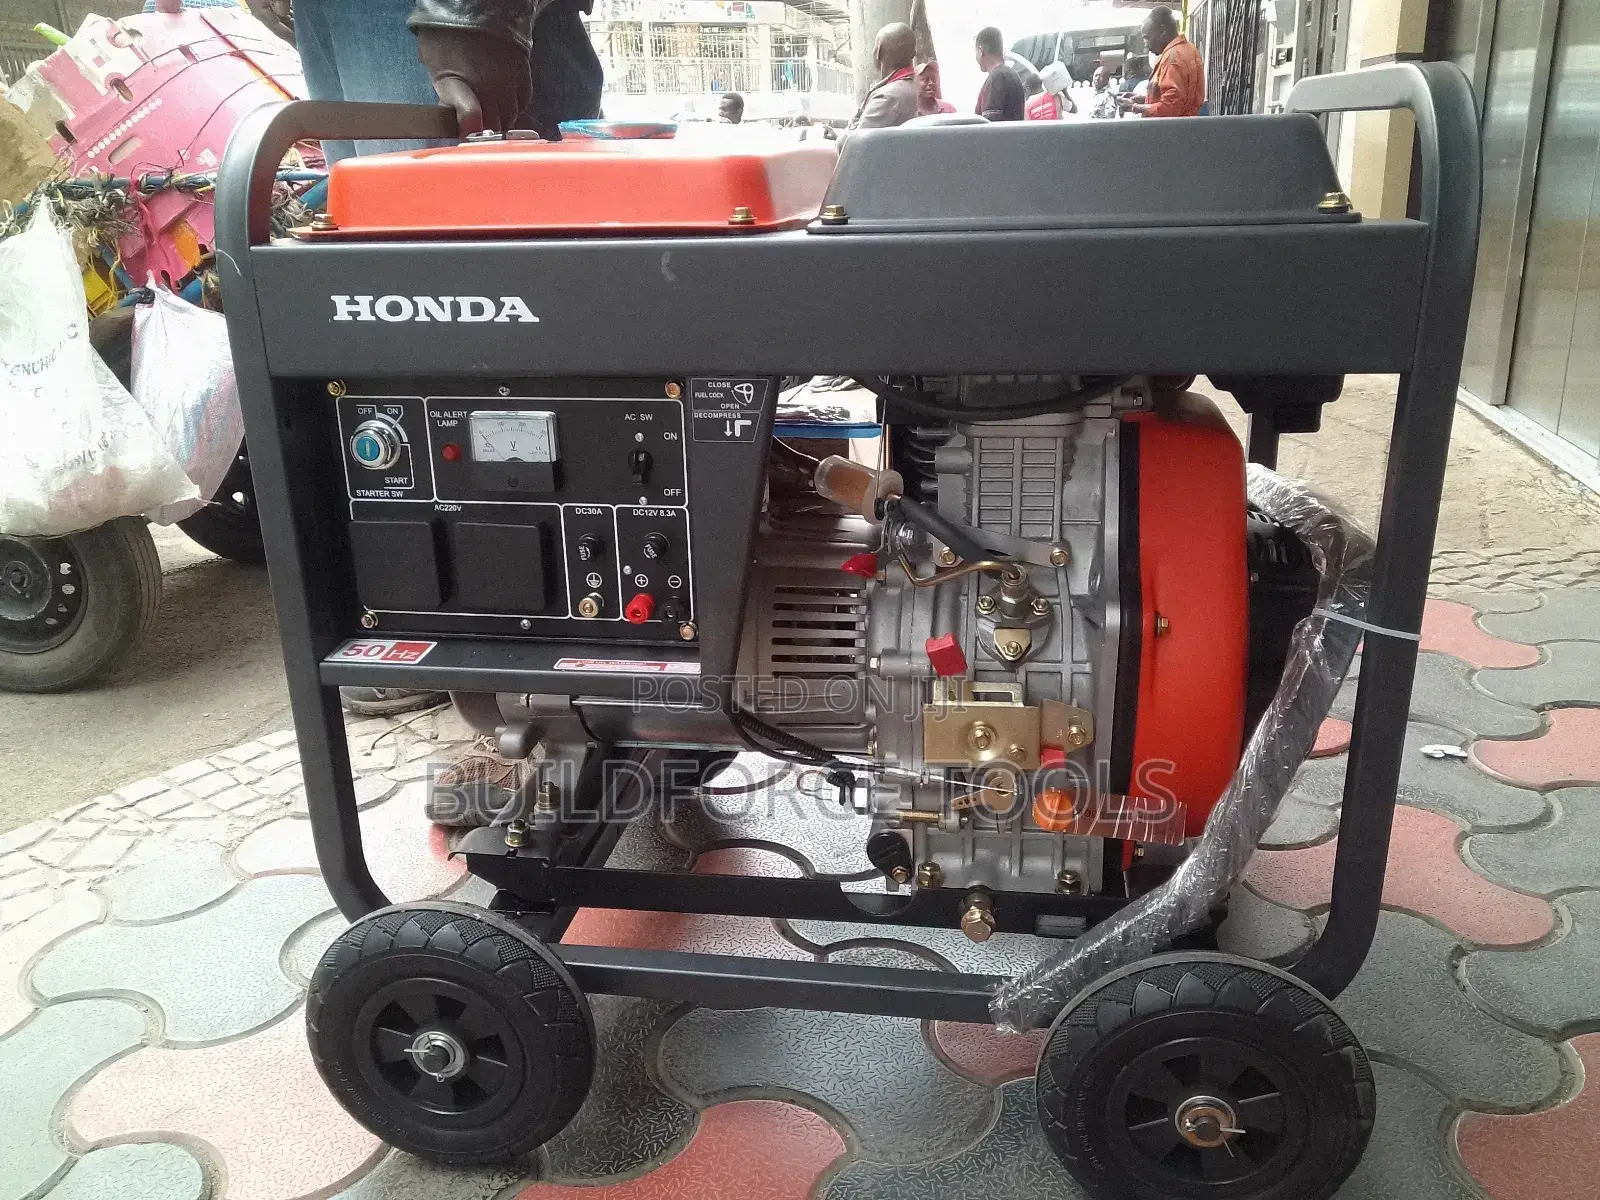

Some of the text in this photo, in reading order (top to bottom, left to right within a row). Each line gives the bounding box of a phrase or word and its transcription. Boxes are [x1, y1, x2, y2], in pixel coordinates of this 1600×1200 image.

[330, 295, 540, 322] HONDA
[357, 407, 373, 415] OFF
[386, 407, 399, 415] ON
[429, 410, 468, 419] OIL ALERT
[624, 413, 653, 421] AC SW
[663, 431, 678, 441] ON
[384, 477, 409, 485] START
[356, 489, 404, 498] STARTER SW
[663, 488, 682, 497] OFF
[434, 503, 462, 512] AC220V
[575, 507, 603, 516] DC30A
[633, 508, 677, 518] DC12V 8.3A
[578, 545, 588, 561] FUSE
[645, 543, 658, 559] FUSE
[341, 643, 420, 660] 50 Hz
